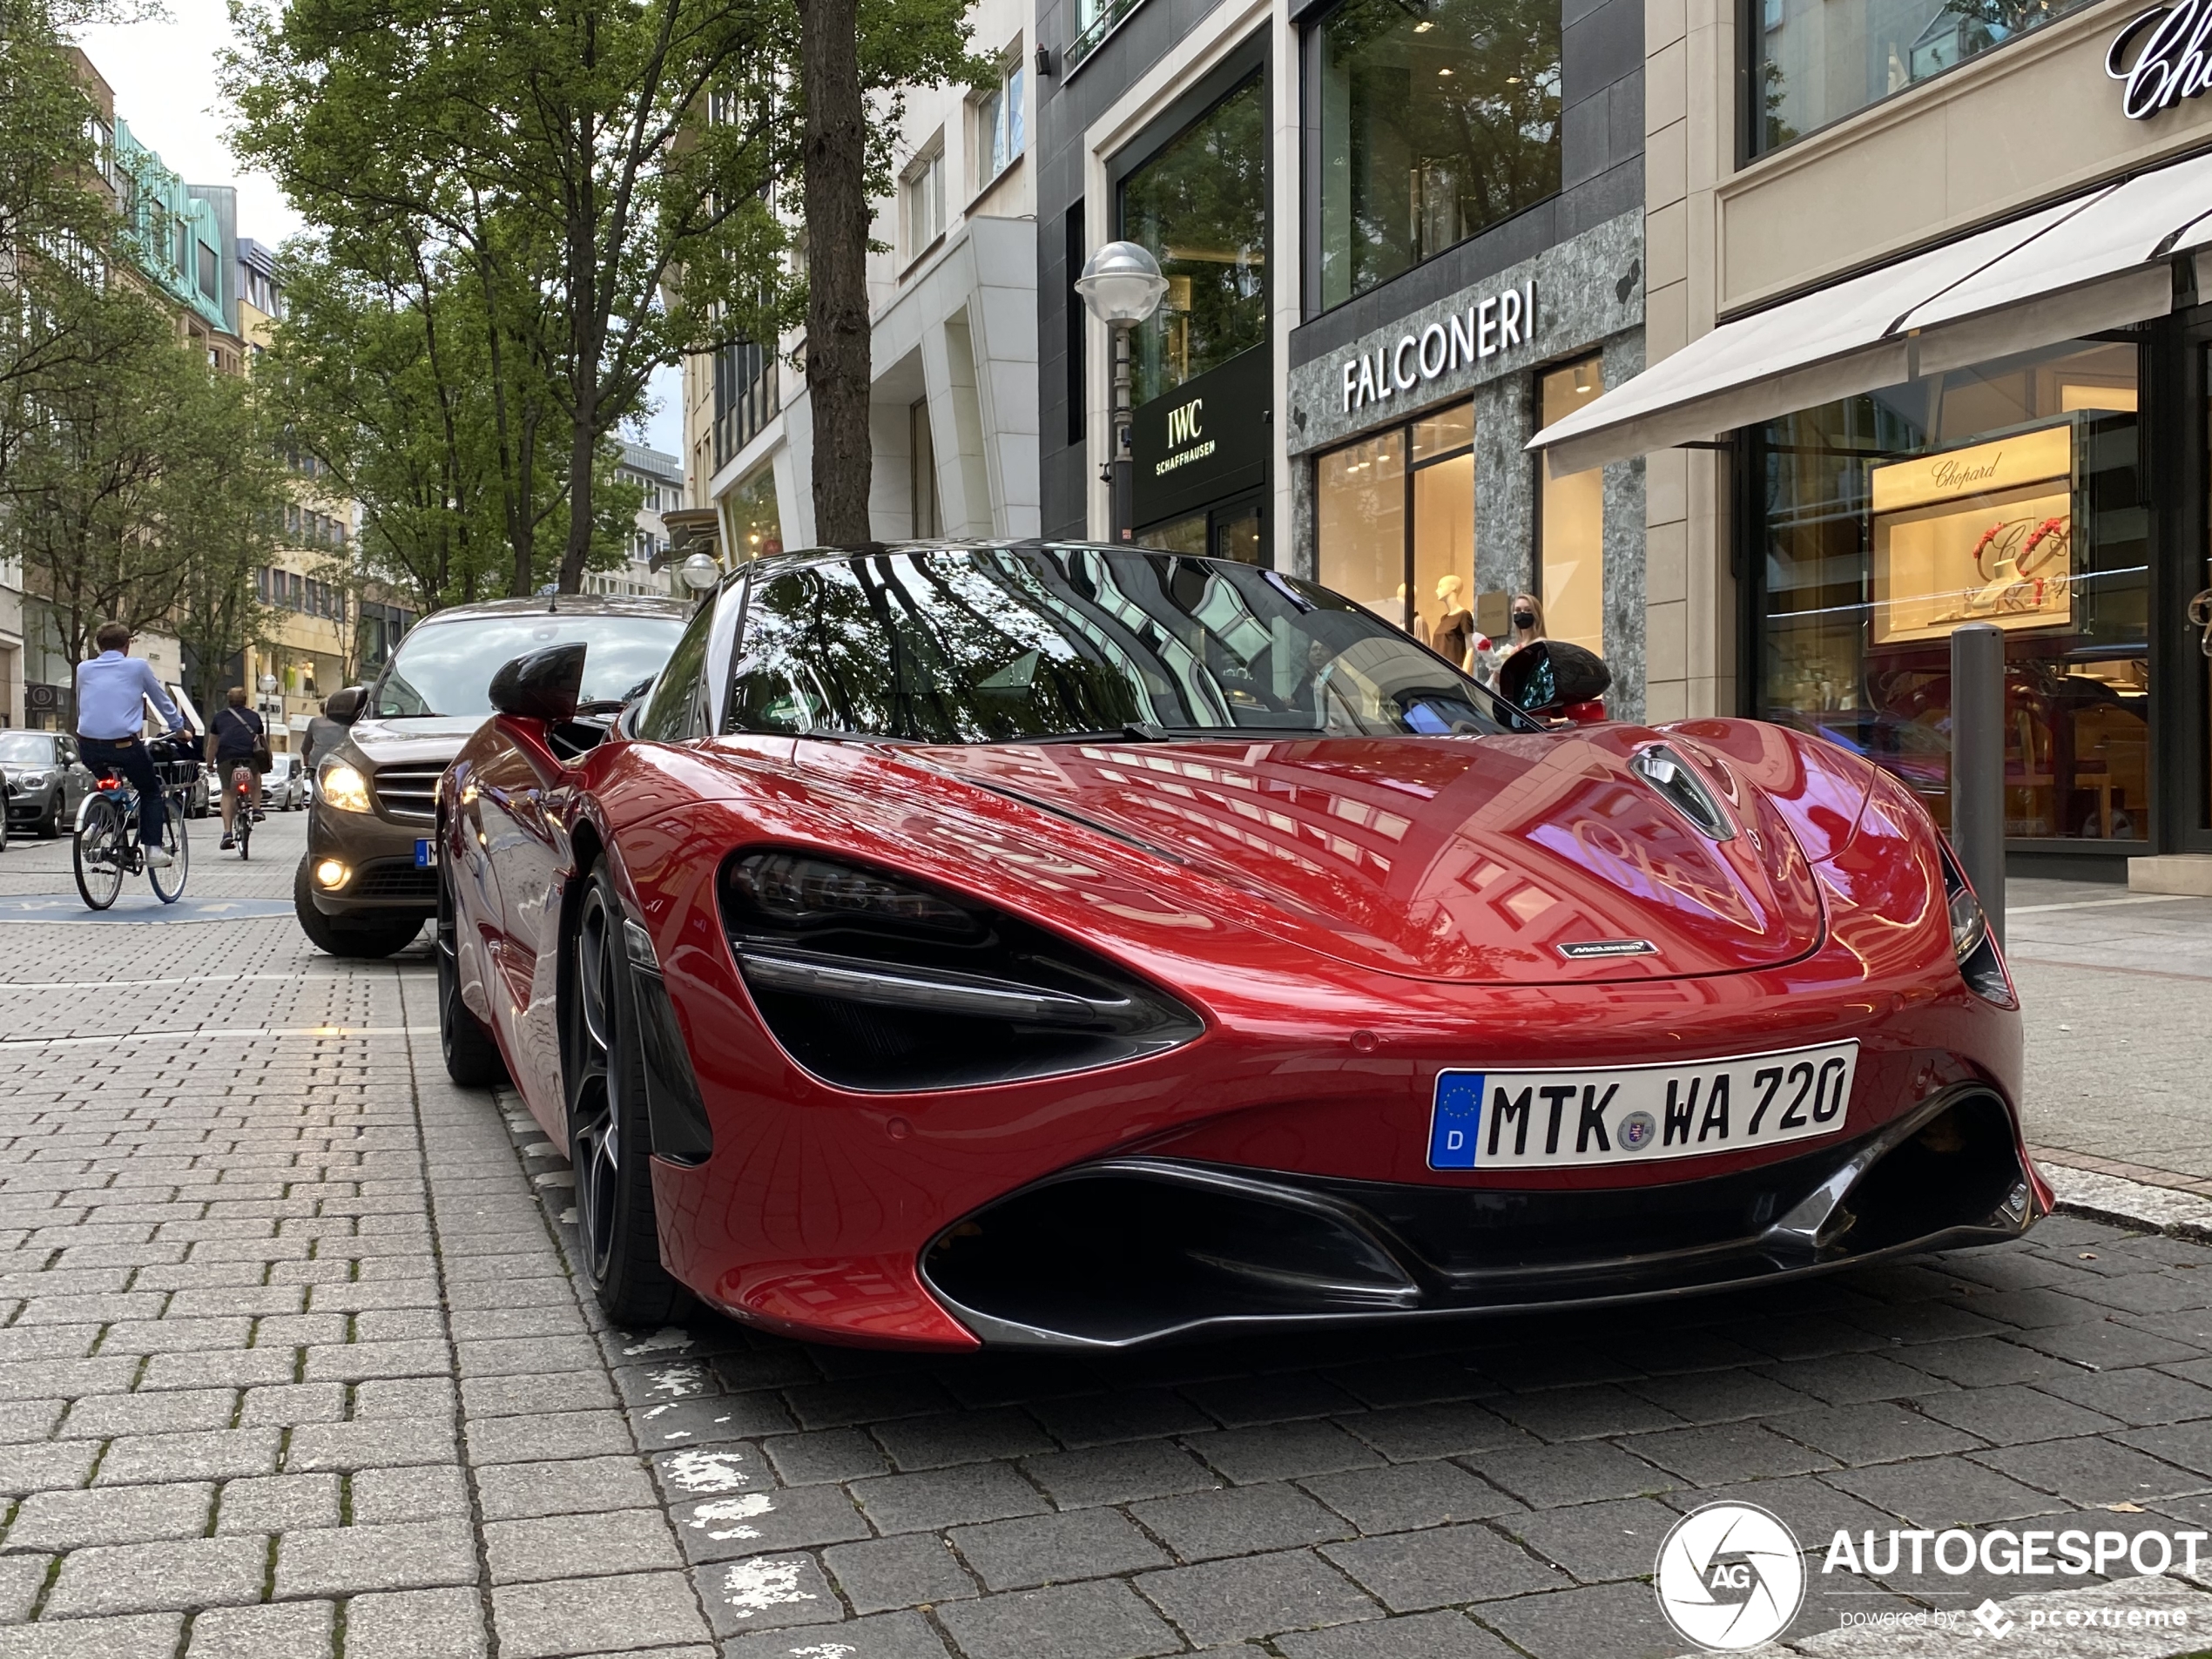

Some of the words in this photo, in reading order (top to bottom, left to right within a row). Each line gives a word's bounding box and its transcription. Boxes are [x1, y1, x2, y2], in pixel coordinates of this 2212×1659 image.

[1344, 280, 1538, 412] FALCONERI
[1168, 398, 1202, 448] IWC
[1156, 440, 1215, 475] SCHAFFHAUSEN
[1932, 452, 2002, 489] Chopard
[1572, 943, 1642, 954] McLaren
[1487, 1084, 1619, 1155] MTK
[1663, 1073, 1729, 1146] WA
[1748, 1057, 1845, 1135] 720
[1447, 1130, 1463, 1150] D
